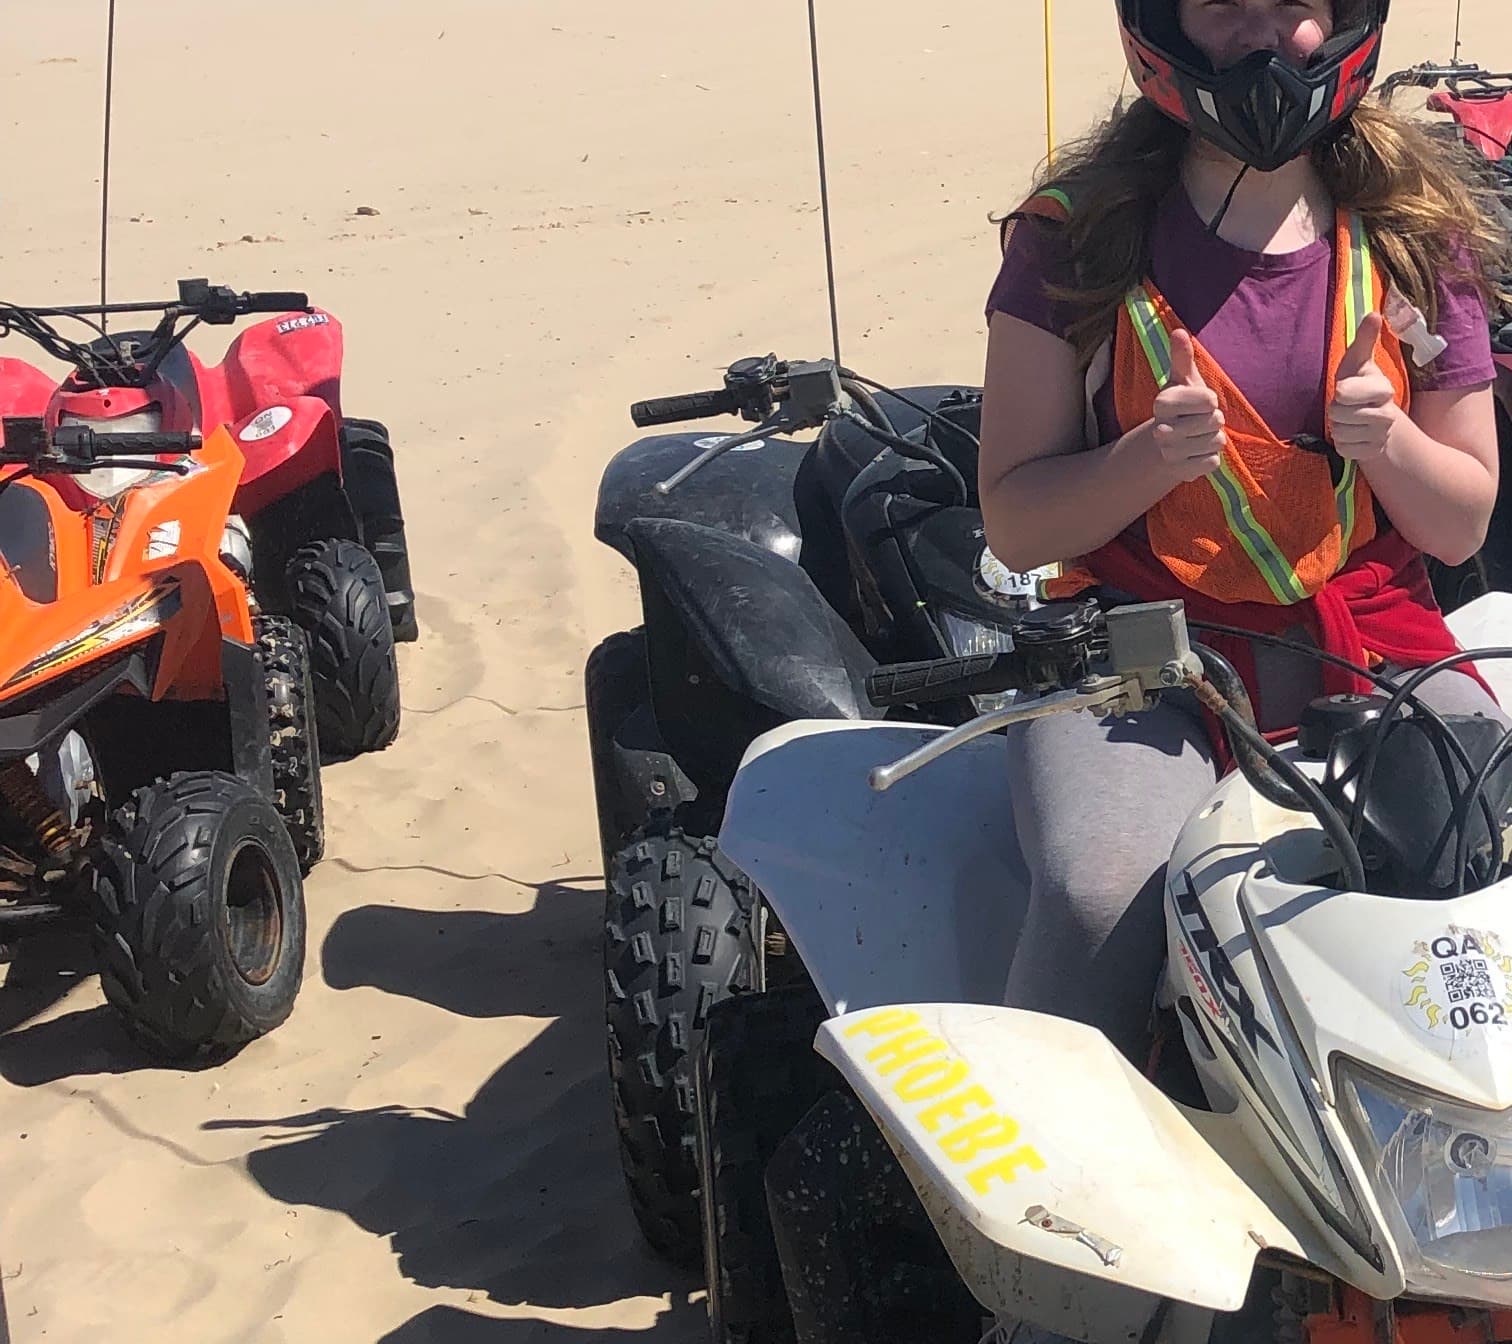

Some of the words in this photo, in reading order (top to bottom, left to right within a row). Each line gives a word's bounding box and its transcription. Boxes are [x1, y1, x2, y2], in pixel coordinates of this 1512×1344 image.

[1175, 869, 1285, 1061] TRX
[1431, 935, 1484, 959] QA
[1449, 1001, 1509, 1030] 062
[843, 1008, 1047, 1197] PHOEBE
